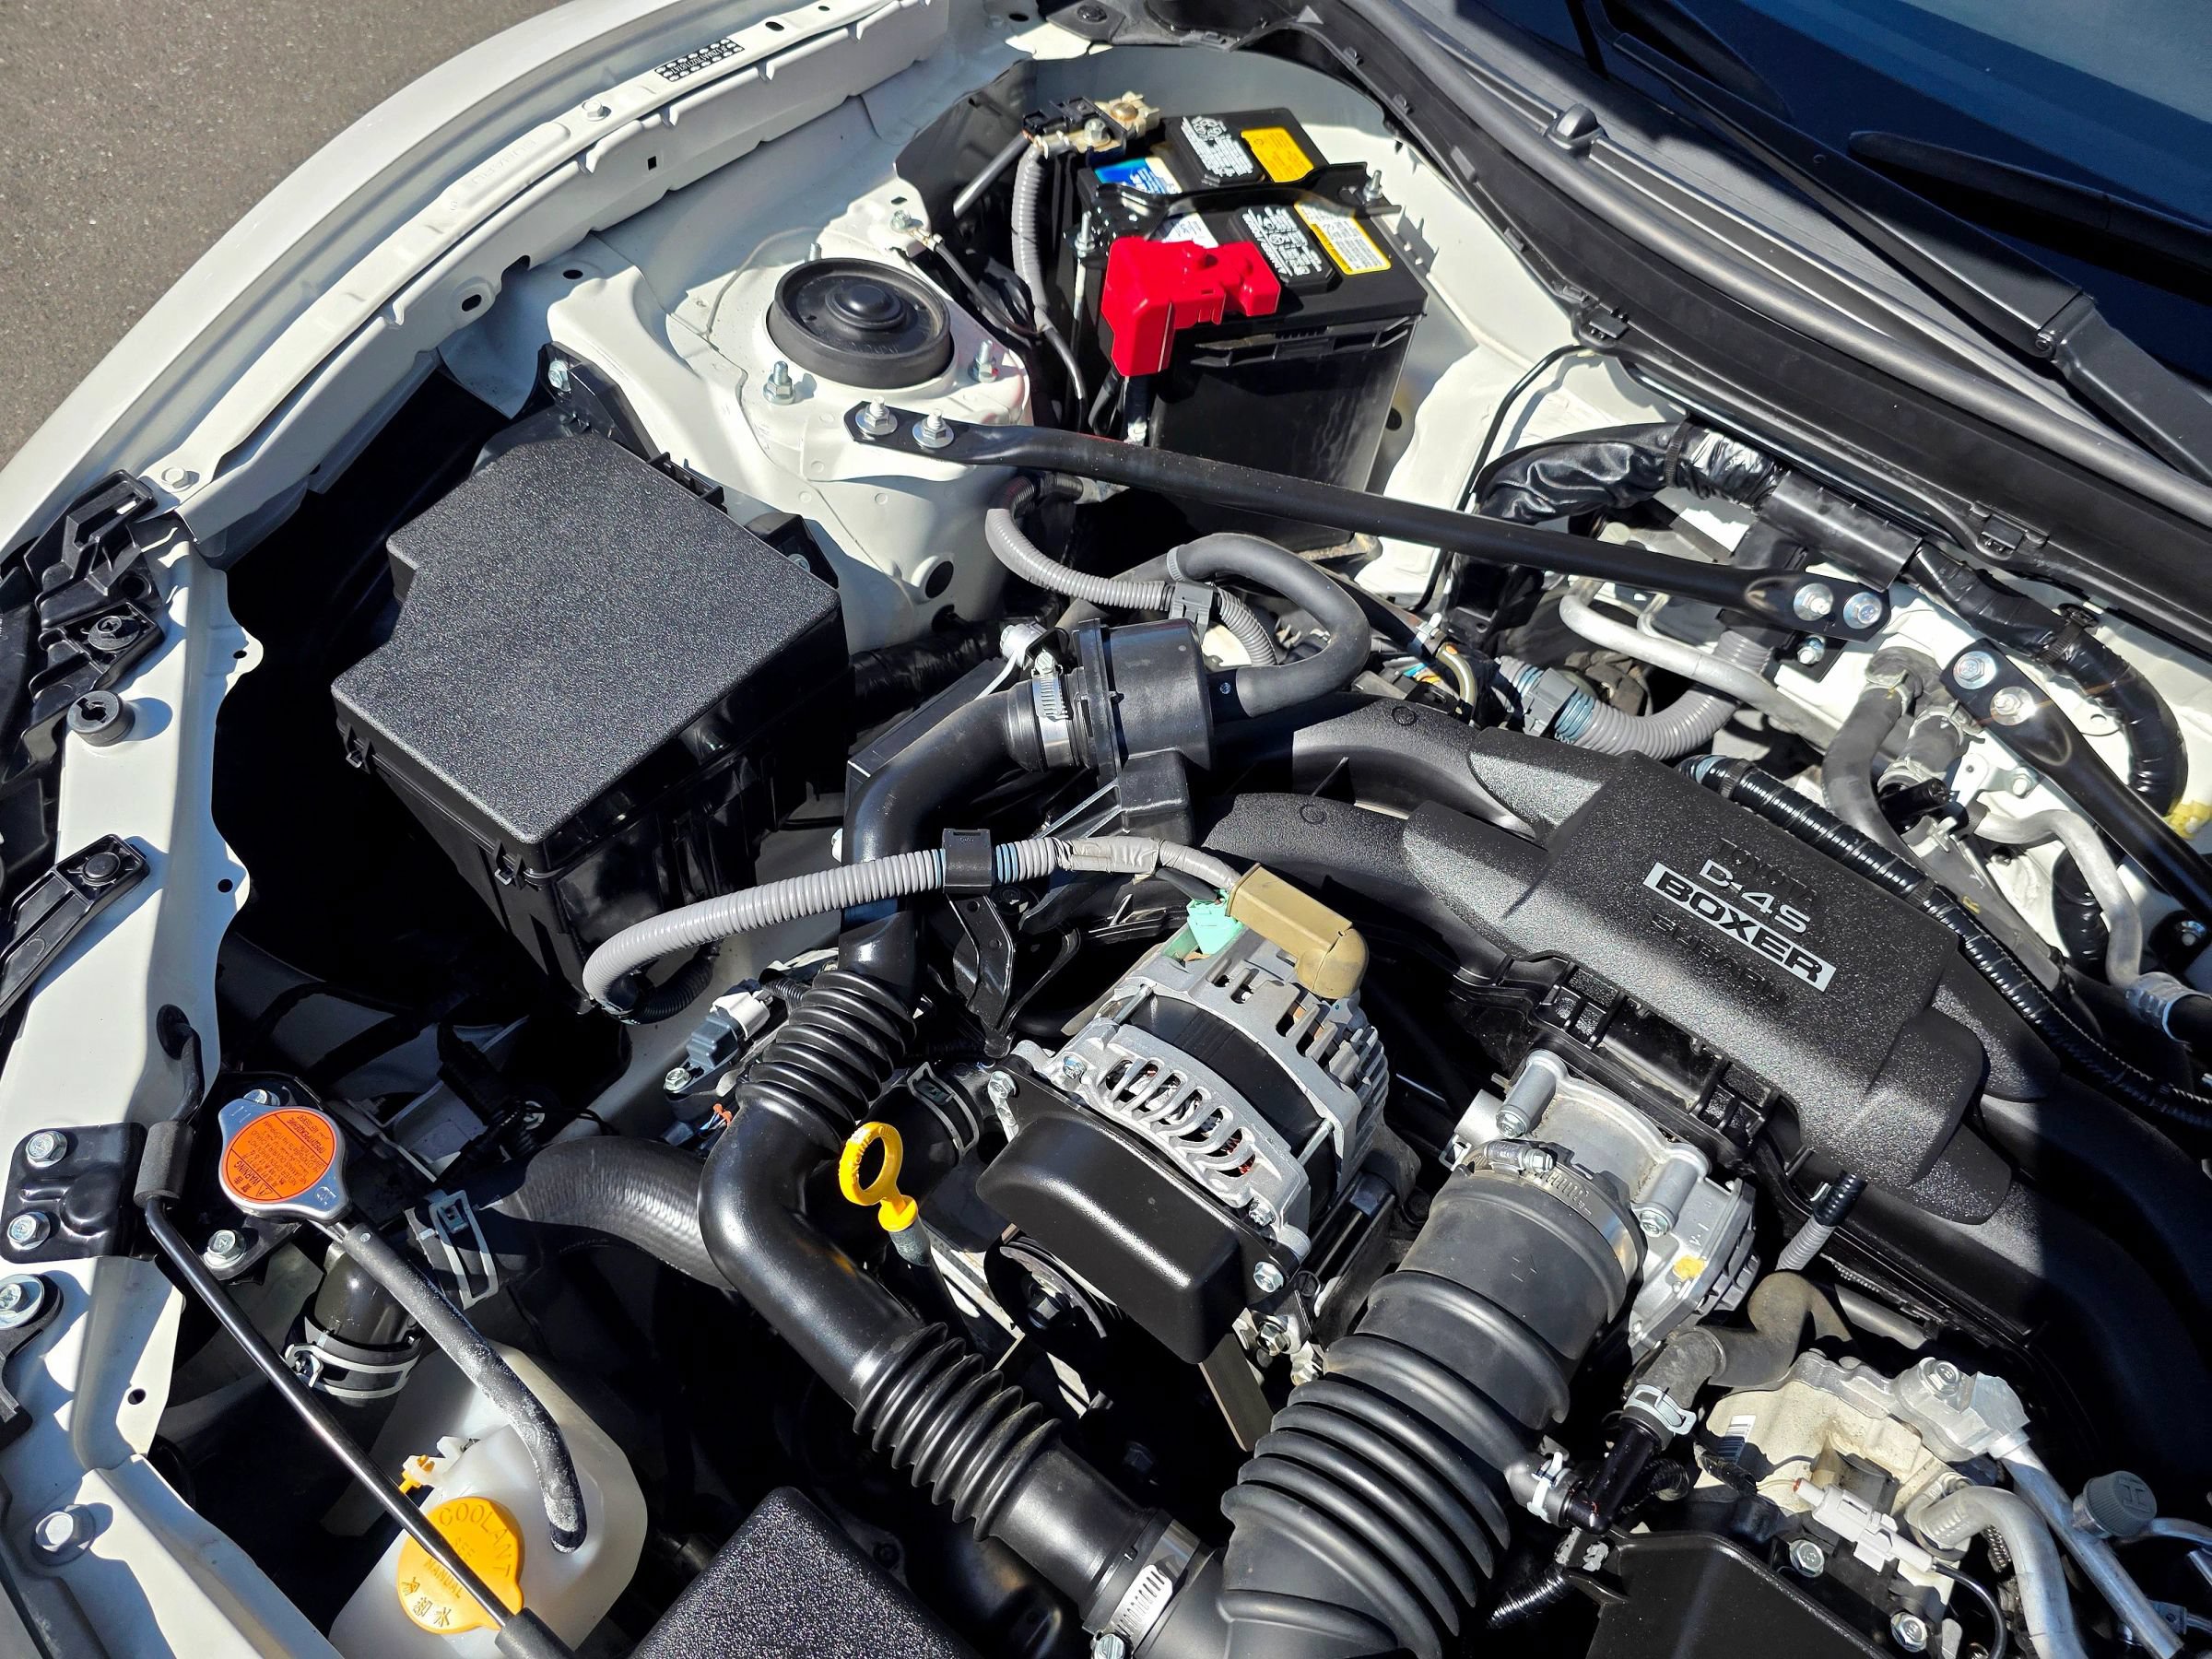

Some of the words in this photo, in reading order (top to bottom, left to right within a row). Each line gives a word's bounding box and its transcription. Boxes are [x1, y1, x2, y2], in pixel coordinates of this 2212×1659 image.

[1718, 837, 1819, 905] TOYOTA
[1699, 859, 1812, 935] D-4S
[1655, 870, 1824, 982] BOXER
[1650, 912, 1789, 1006] SUBARU
[233, 1159, 261, 1186] WARNING
[255, 1145, 271, 1160] WHEN
[268, 1158, 284, 1171] OPEN
[280, 1169, 298, 1185] NEVER
[438, 1504, 512, 1578] COOLANT
[453, 1535, 477, 1559] SEE
[423, 1556, 465, 1598] MANUAL
